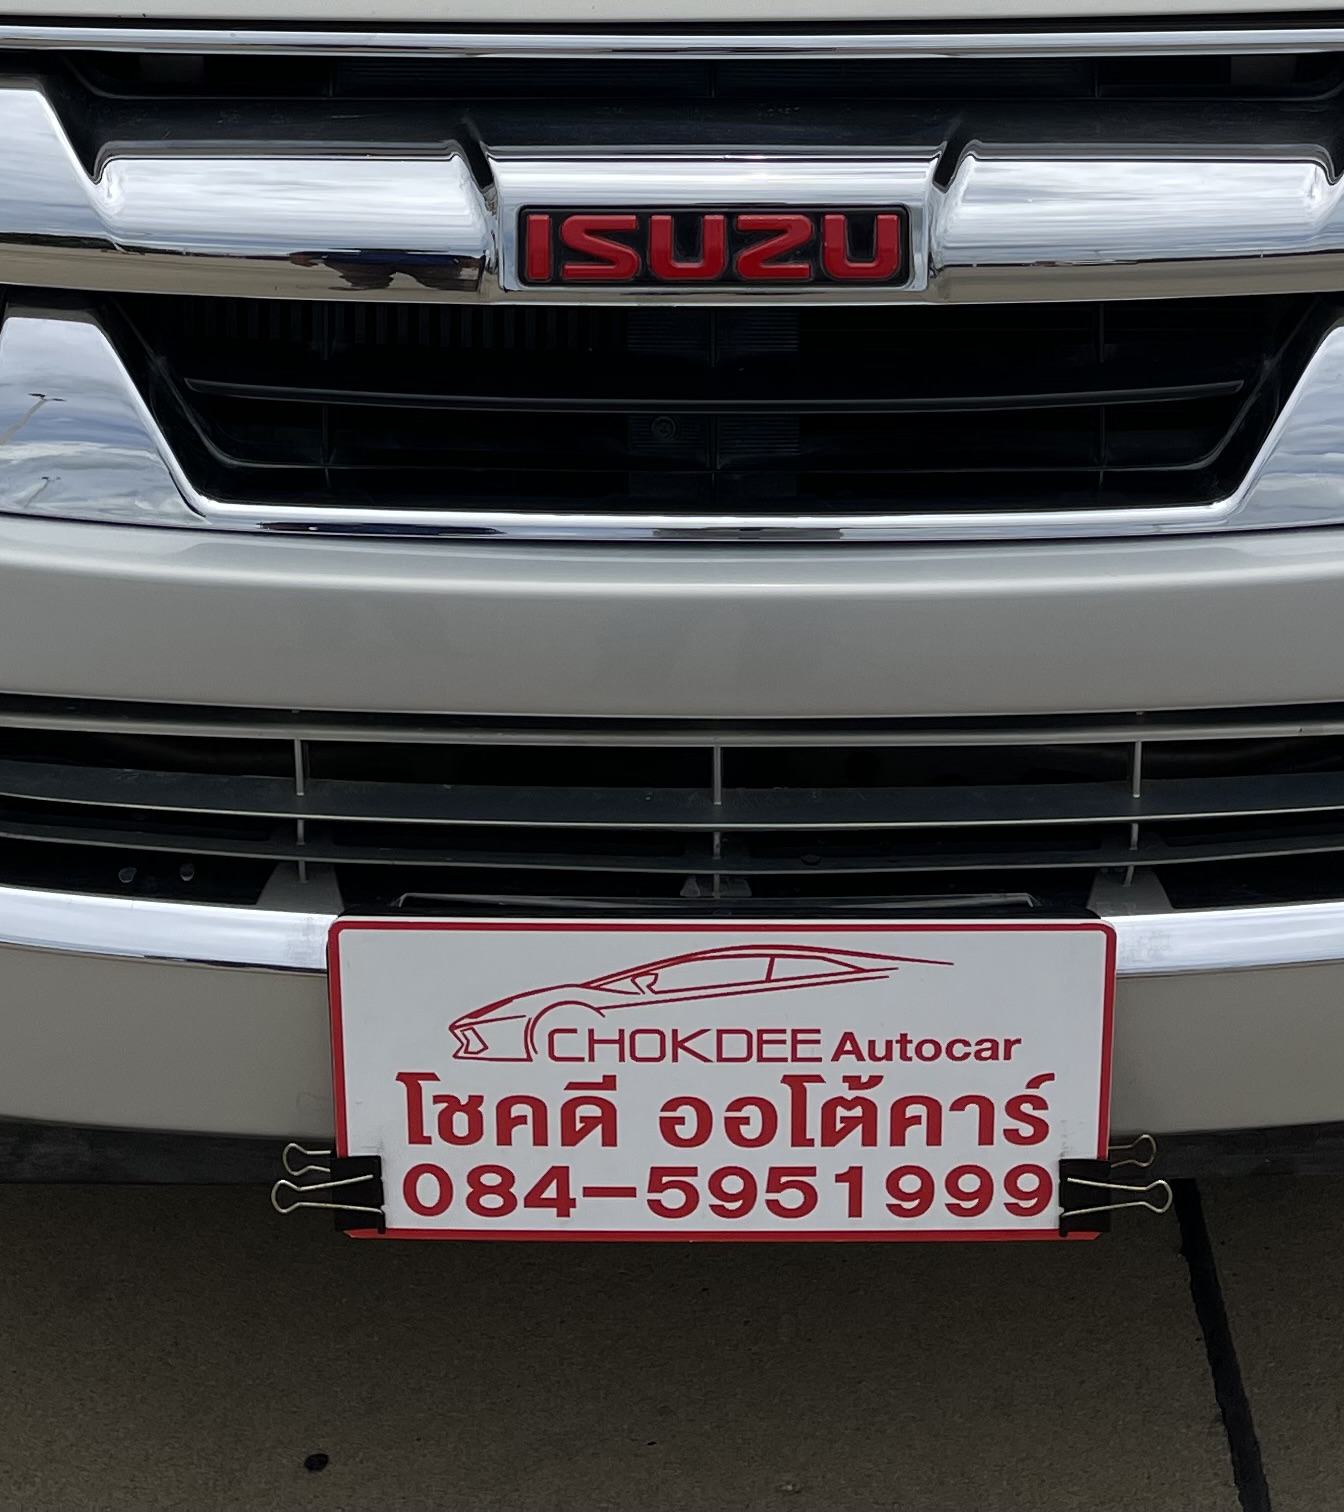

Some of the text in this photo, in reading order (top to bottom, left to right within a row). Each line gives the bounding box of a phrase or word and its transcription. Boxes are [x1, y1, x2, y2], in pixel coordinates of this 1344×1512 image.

[526, 213, 900, 280] ISUZU
[546, 1027, 1023, 1064] CHOKDEE Autocar
[394, 1071, 1056, 1149] โชคดี ออโต้คาร์
[401, 1162, 1054, 1220] 084-5951999
